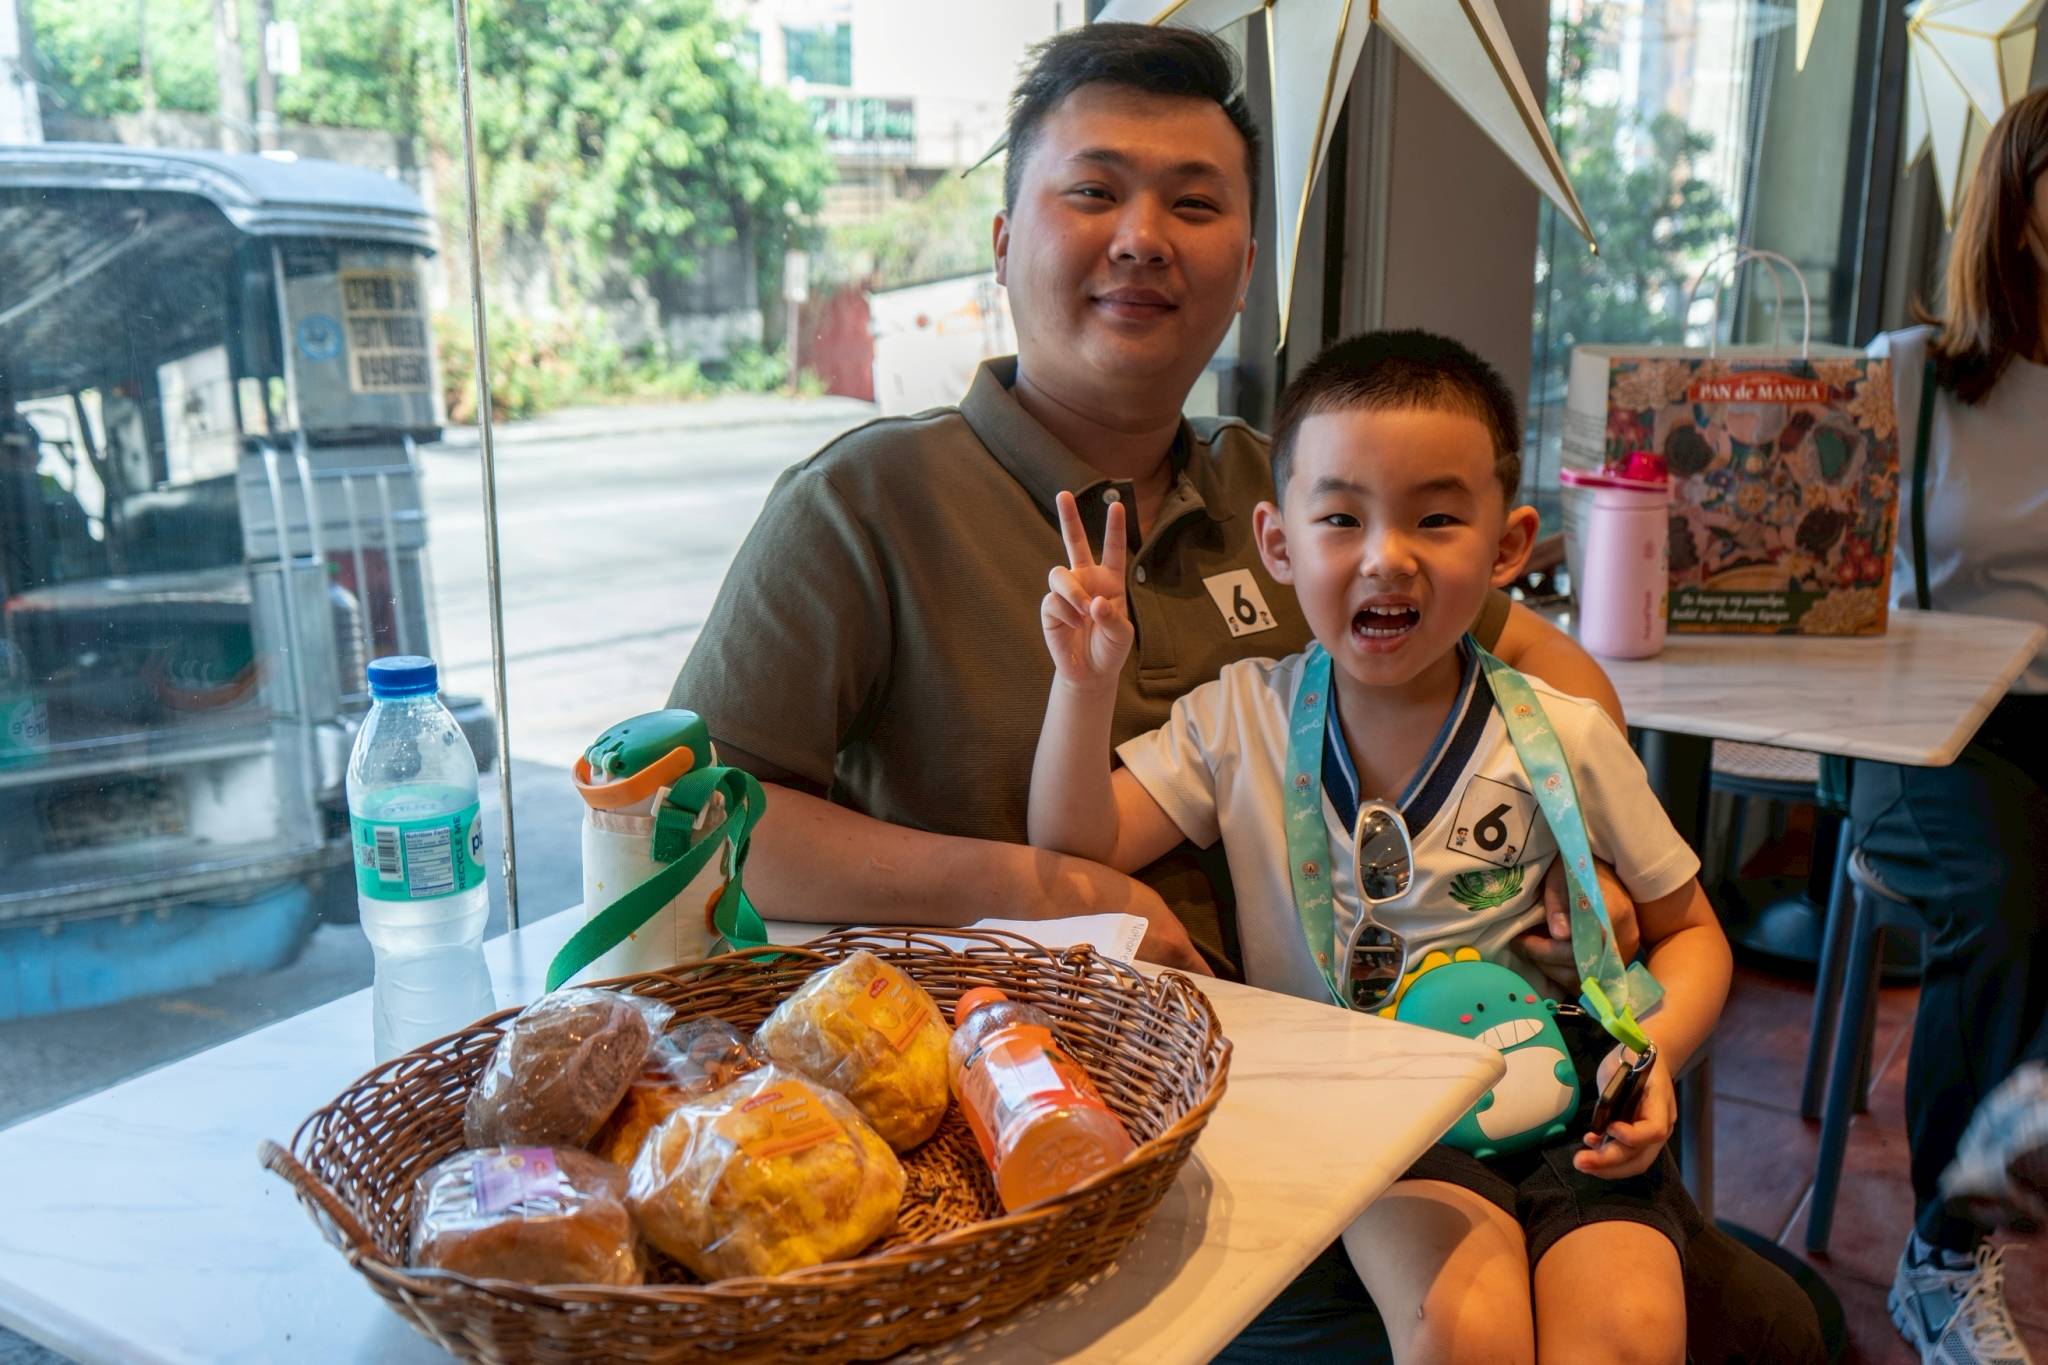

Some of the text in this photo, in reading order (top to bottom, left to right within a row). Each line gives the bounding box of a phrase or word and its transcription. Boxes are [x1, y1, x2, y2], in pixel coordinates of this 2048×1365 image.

[1701, 384, 1819, 400] PAN de MANILA
[1233, 584, 1257, 626] 6
[1473, 803, 1512, 851] 6
[453, 815, 466, 890] RECYCLE ME
